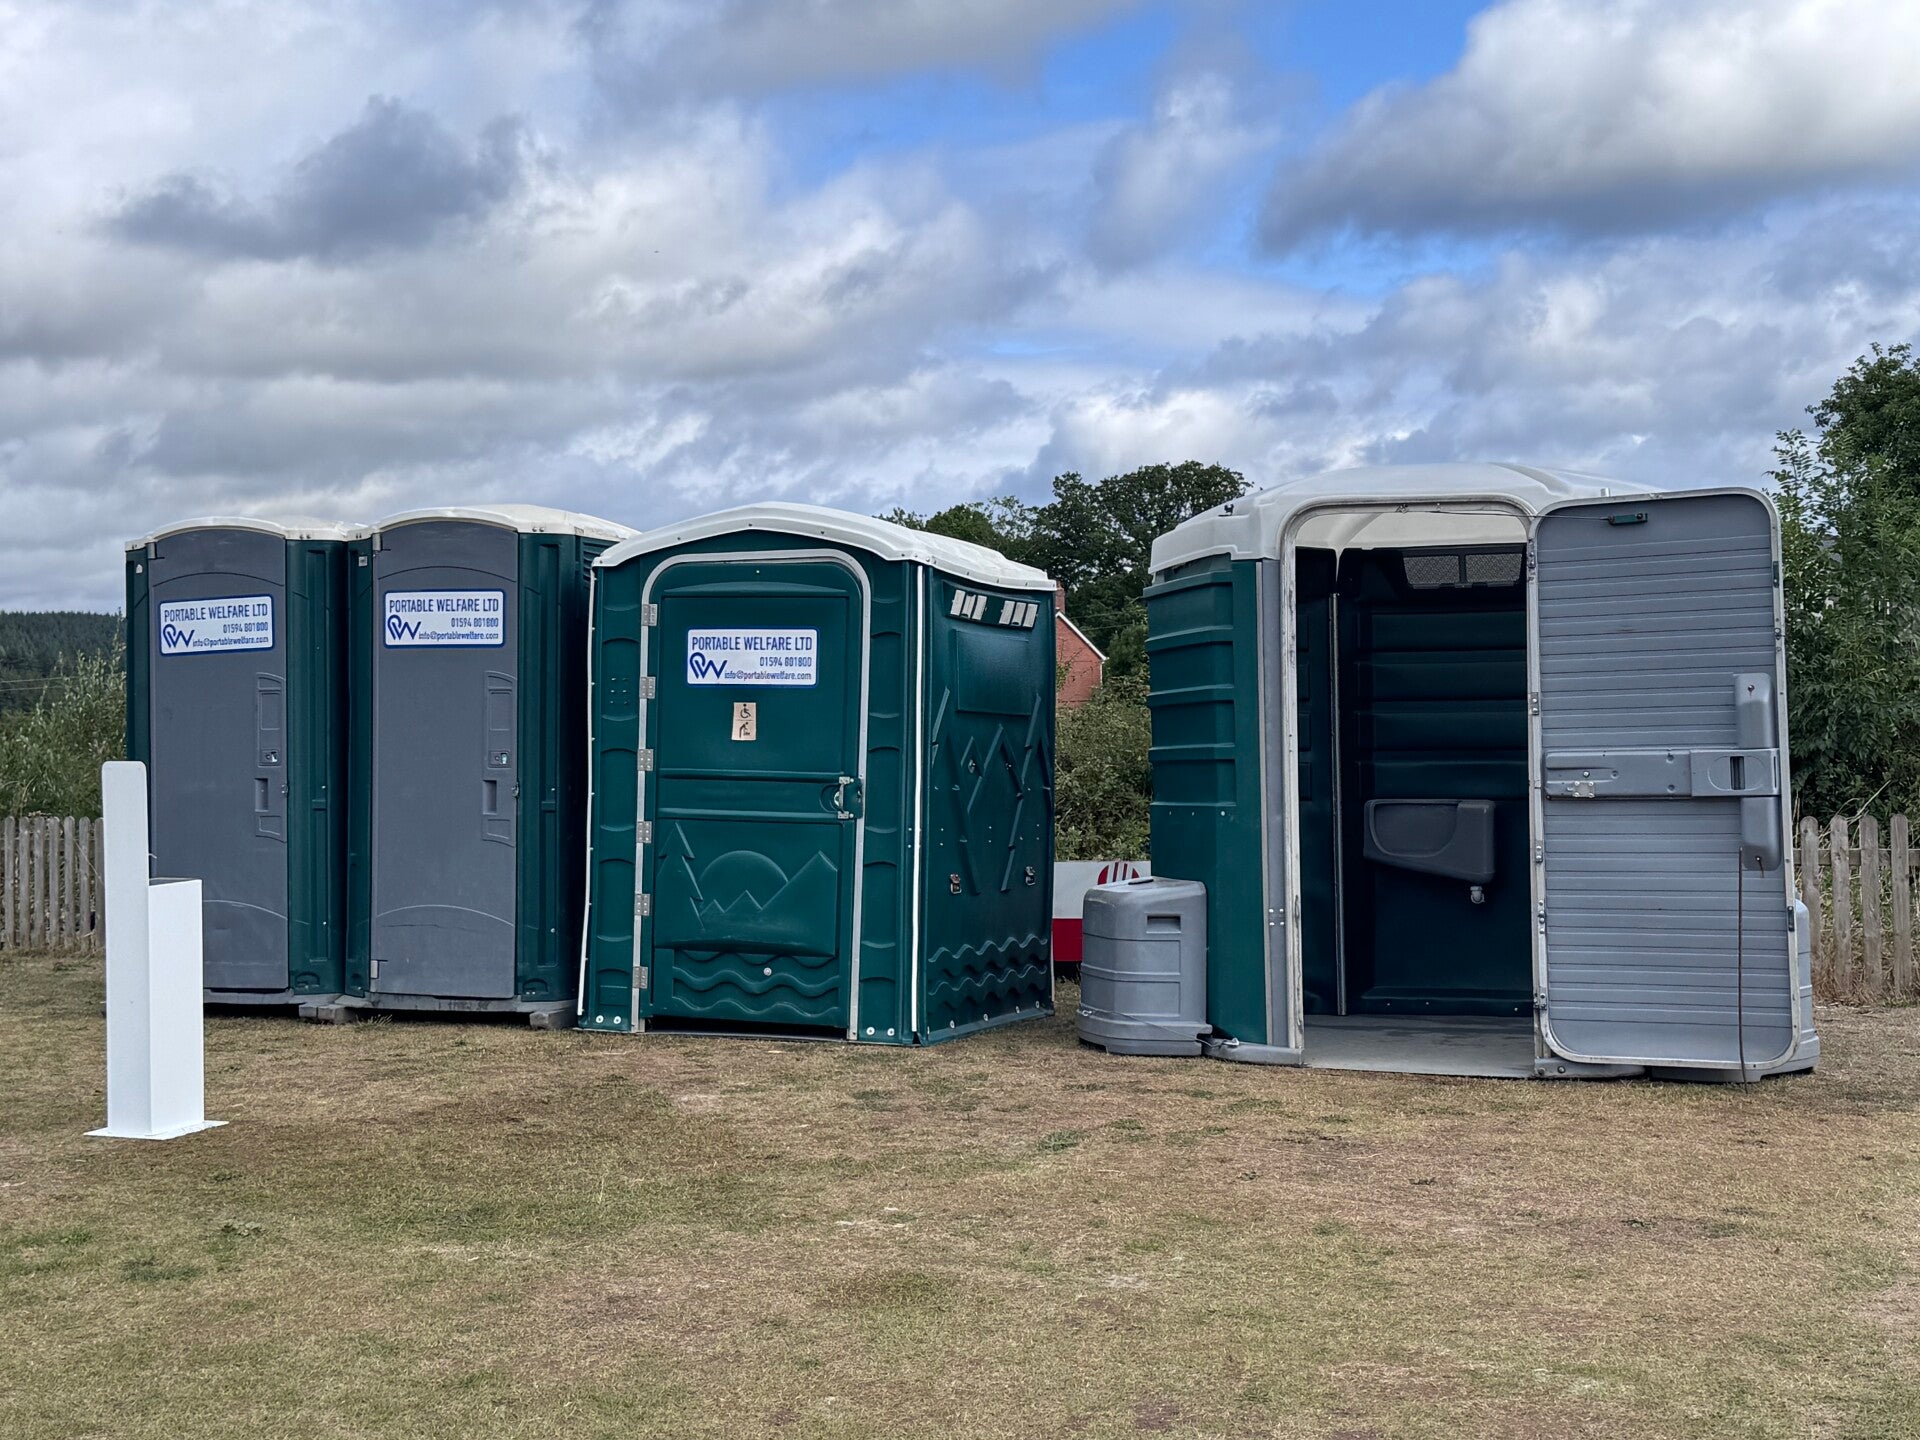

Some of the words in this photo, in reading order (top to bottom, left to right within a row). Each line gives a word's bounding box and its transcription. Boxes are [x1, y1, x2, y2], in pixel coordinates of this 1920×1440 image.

[389, 599, 433, 613] PORTABLE
[437, 599, 479, 611] WELFARE
[483, 599, 498, 611] LTD
[164, 607, 206, 622] PORTABLE
[209, 605, 249, 619] WELFARE
[253, 604, 267, 616] LTD
[451, 618, 471, 627] 01594
[223, 624, 243, 633] 01594
[692, 637, 740, 650] PORTABLE
[744, 637, 791, 650] WELFARE
[795, 637, 812, 650] LTD
[760, 657, 782, 666] 01594
